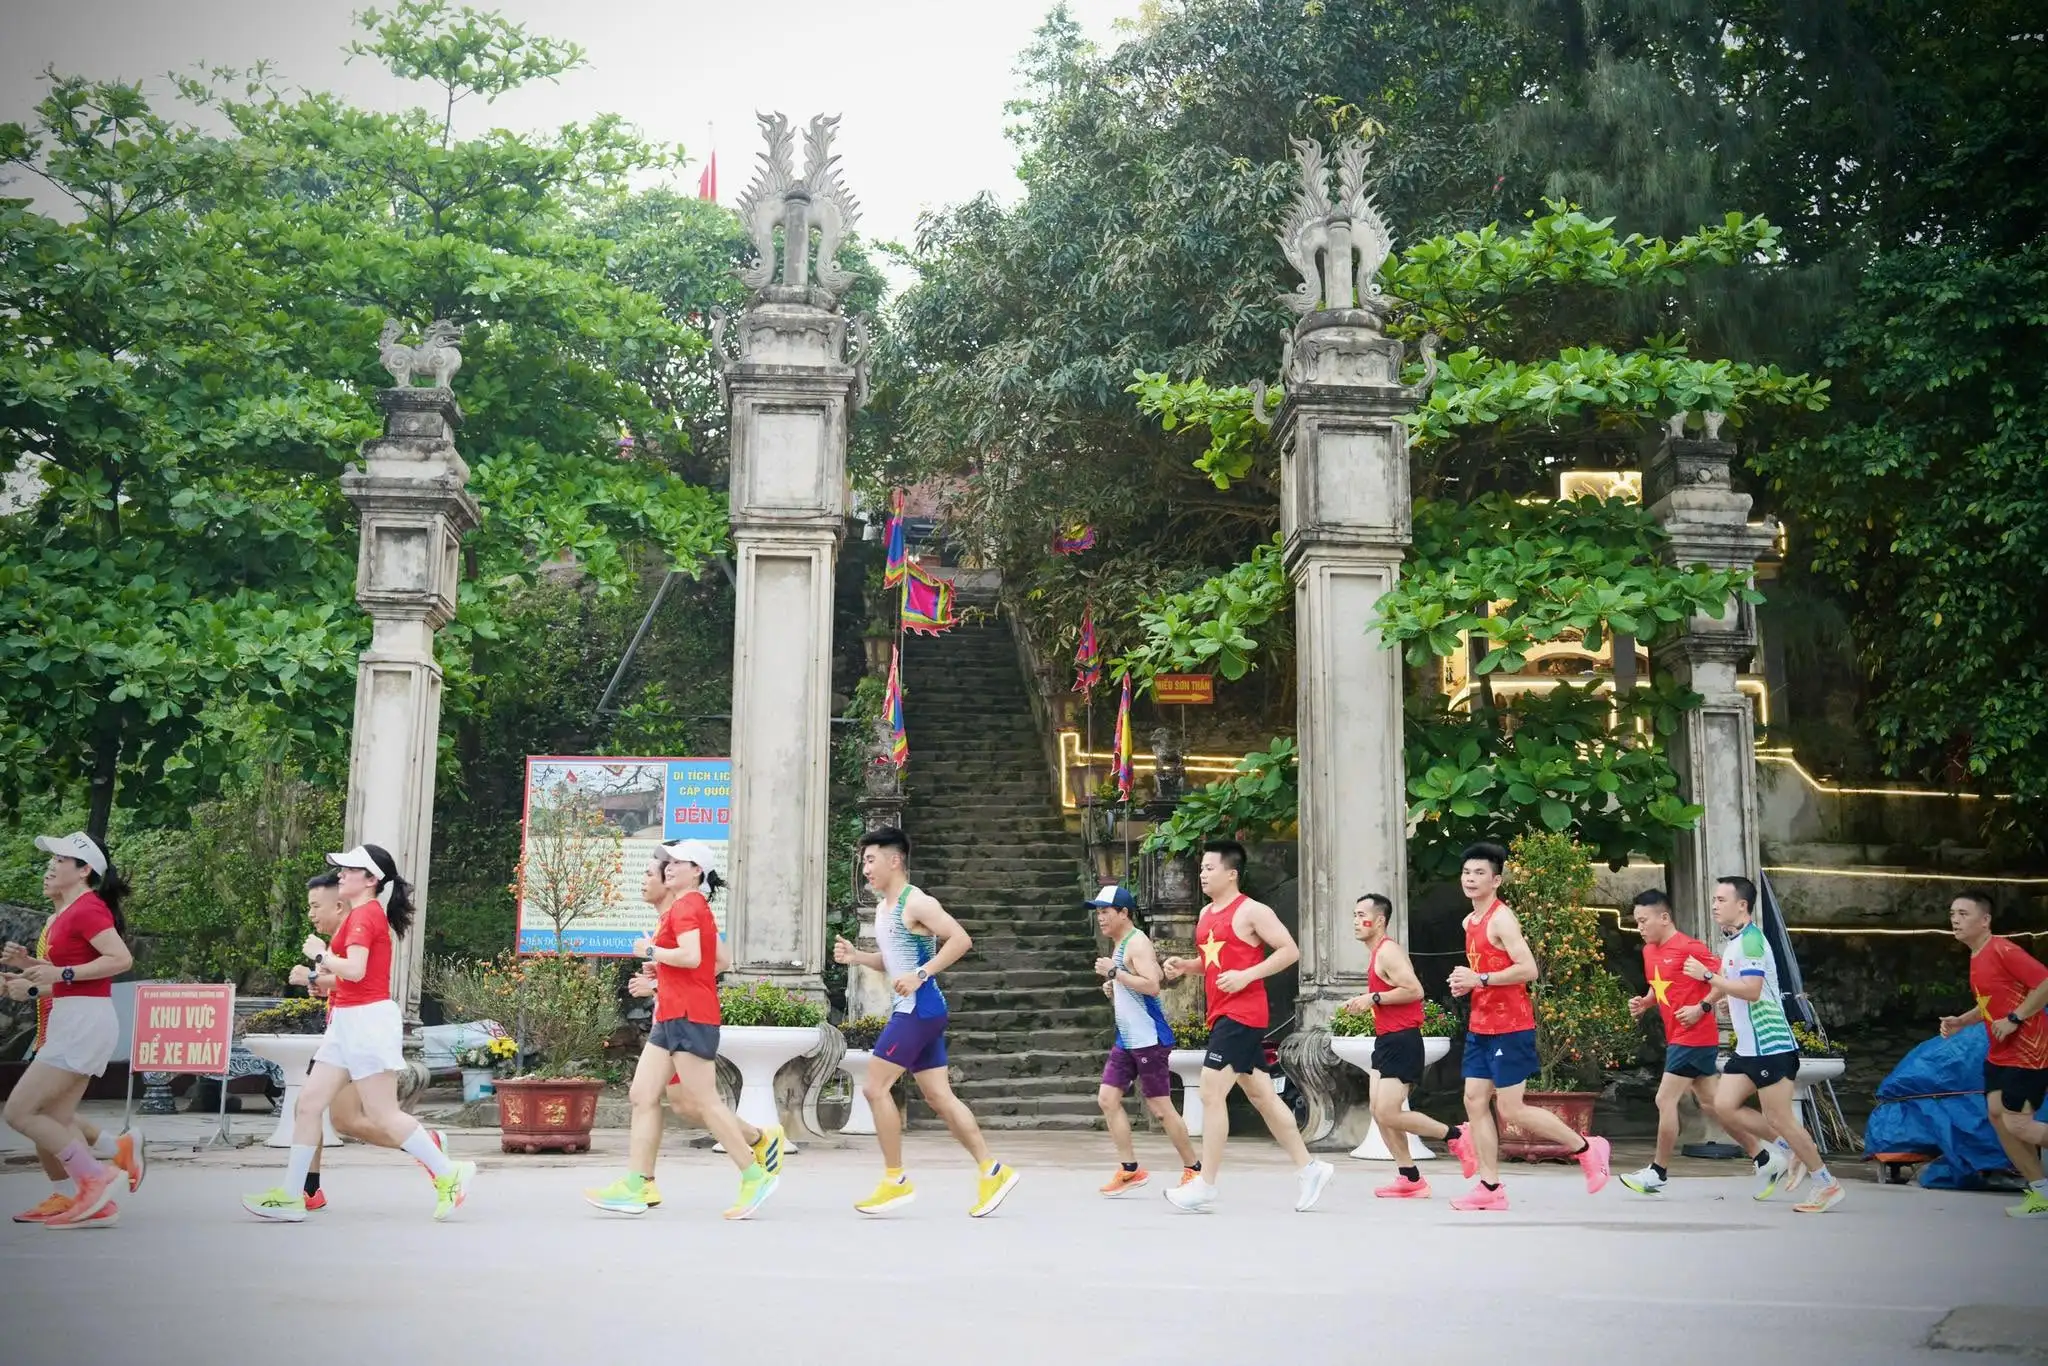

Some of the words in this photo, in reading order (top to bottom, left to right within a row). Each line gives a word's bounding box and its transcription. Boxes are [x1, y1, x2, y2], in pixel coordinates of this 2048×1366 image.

[673, 771, 684, 781] DI
[688, 769, 711, 781] TÍCH
[714, 771, 731, 783] LỊC
[149, 1006, 181, 1029] KHU
[186, 1004, 215, 1034] VỰC
[139, 1033, 160, 1065] ĐỂ
[162, 1042, 183, 1065] XE
[187, 1038, 222, 1065] MÁY
